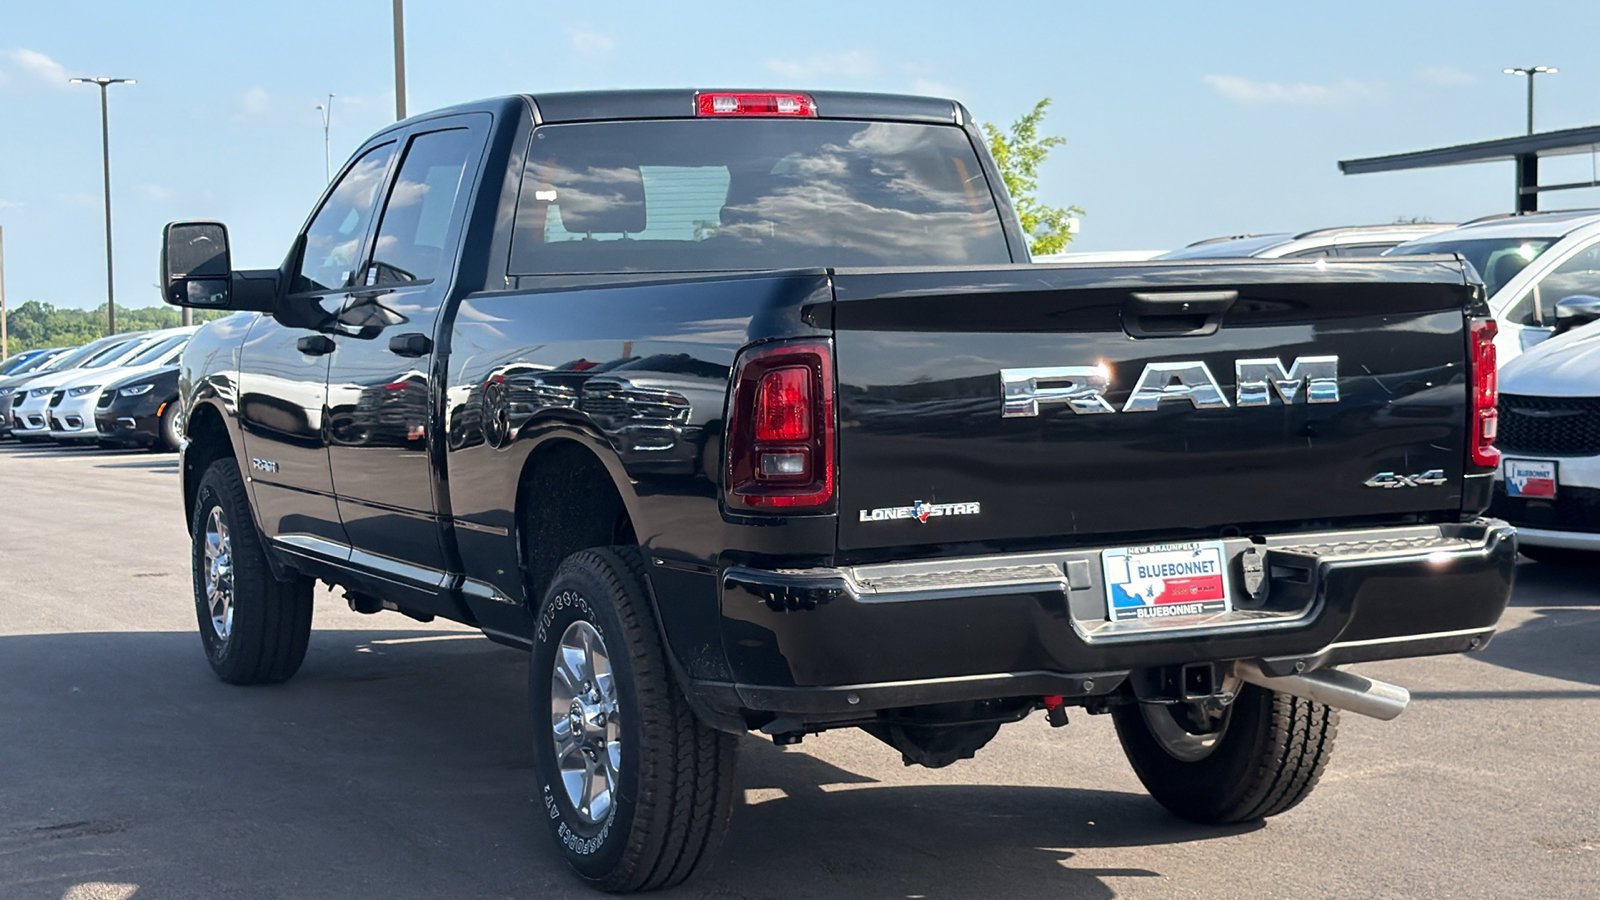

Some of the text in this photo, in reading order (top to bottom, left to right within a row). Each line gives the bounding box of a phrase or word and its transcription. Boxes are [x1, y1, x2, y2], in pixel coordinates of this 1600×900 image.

[999, 354, 1340, 418] RAM
[859, 502, 980, 522] LONE STAR
[1138, 560, 1215, 578] BLUEBONNET
[1137, 603, 1203, 618] BLUEBONNET
